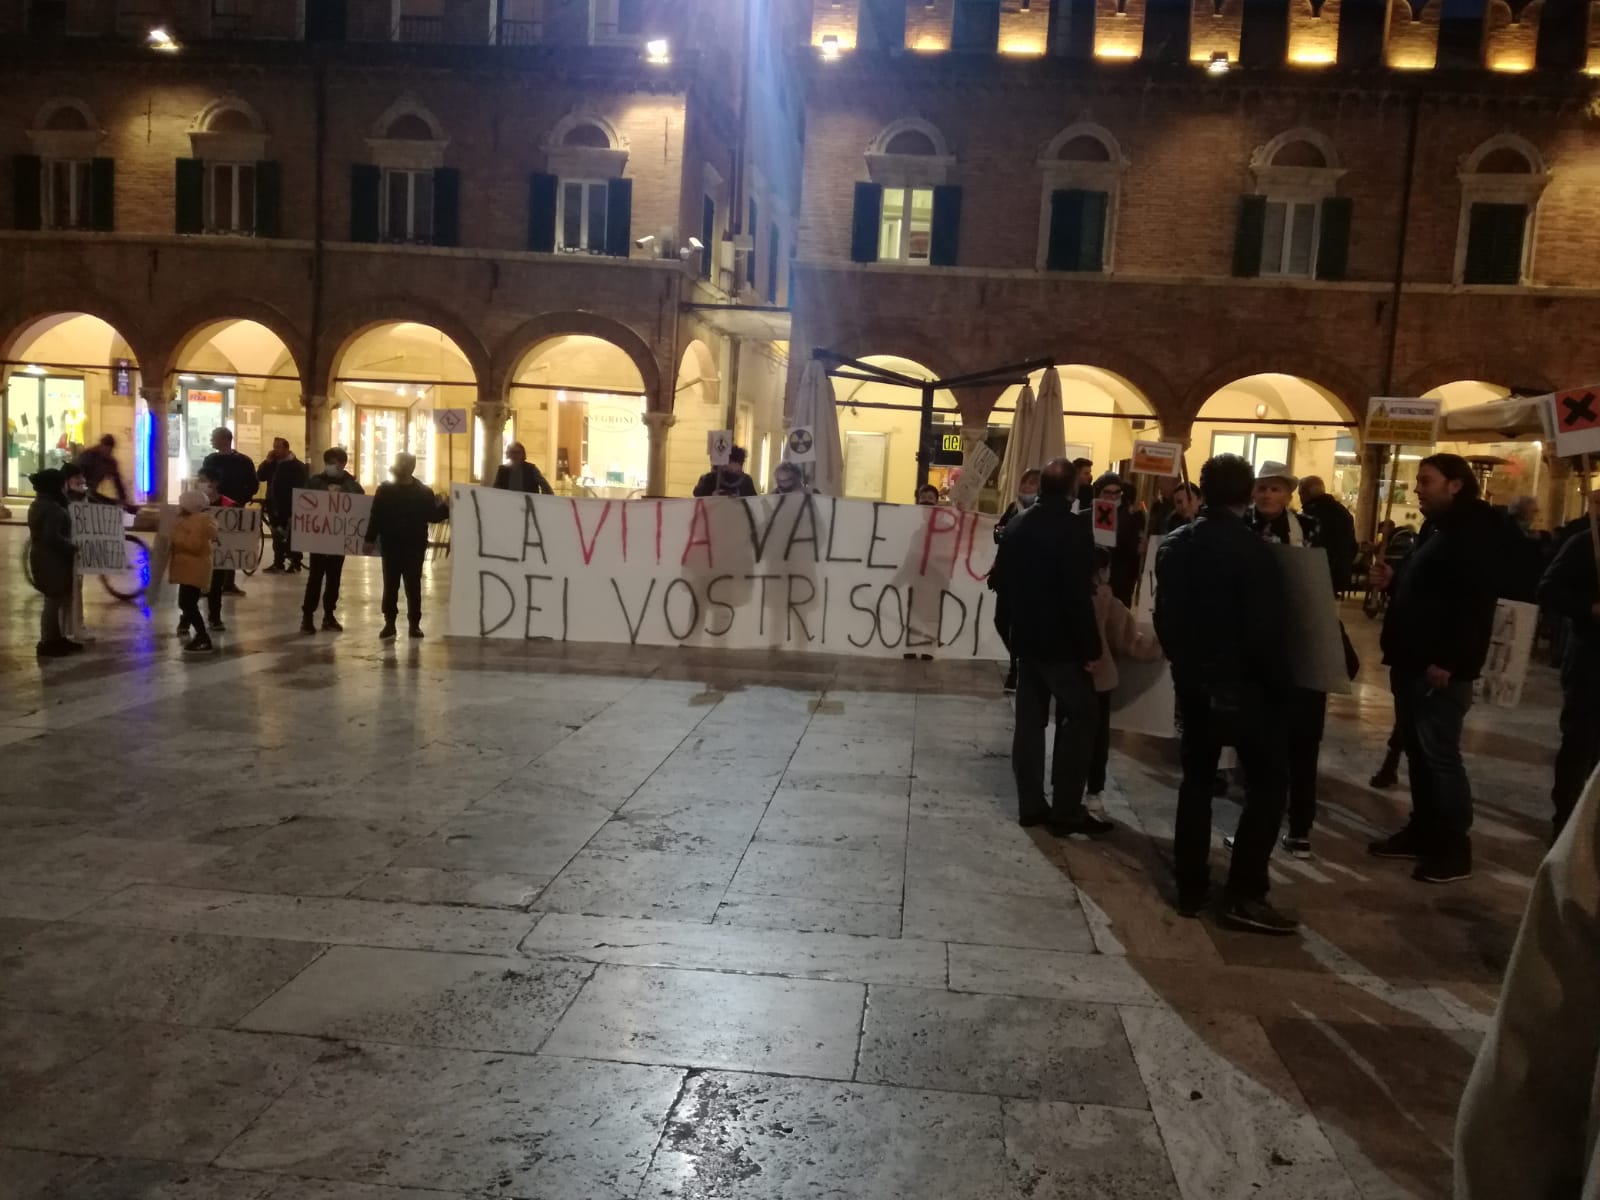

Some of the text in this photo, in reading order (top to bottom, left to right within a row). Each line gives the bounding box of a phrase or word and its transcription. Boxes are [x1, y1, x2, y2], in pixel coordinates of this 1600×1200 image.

[215, 508, 256, 532] COLI
[328, 494, 352, 513] NO
[471, 489, 547, 564] LA
[570, 499, 712, 568] VITA
[741, 495, 898, 569] VALE
[479, 570, 983, 656] DEI VOSTRI SOLDI
